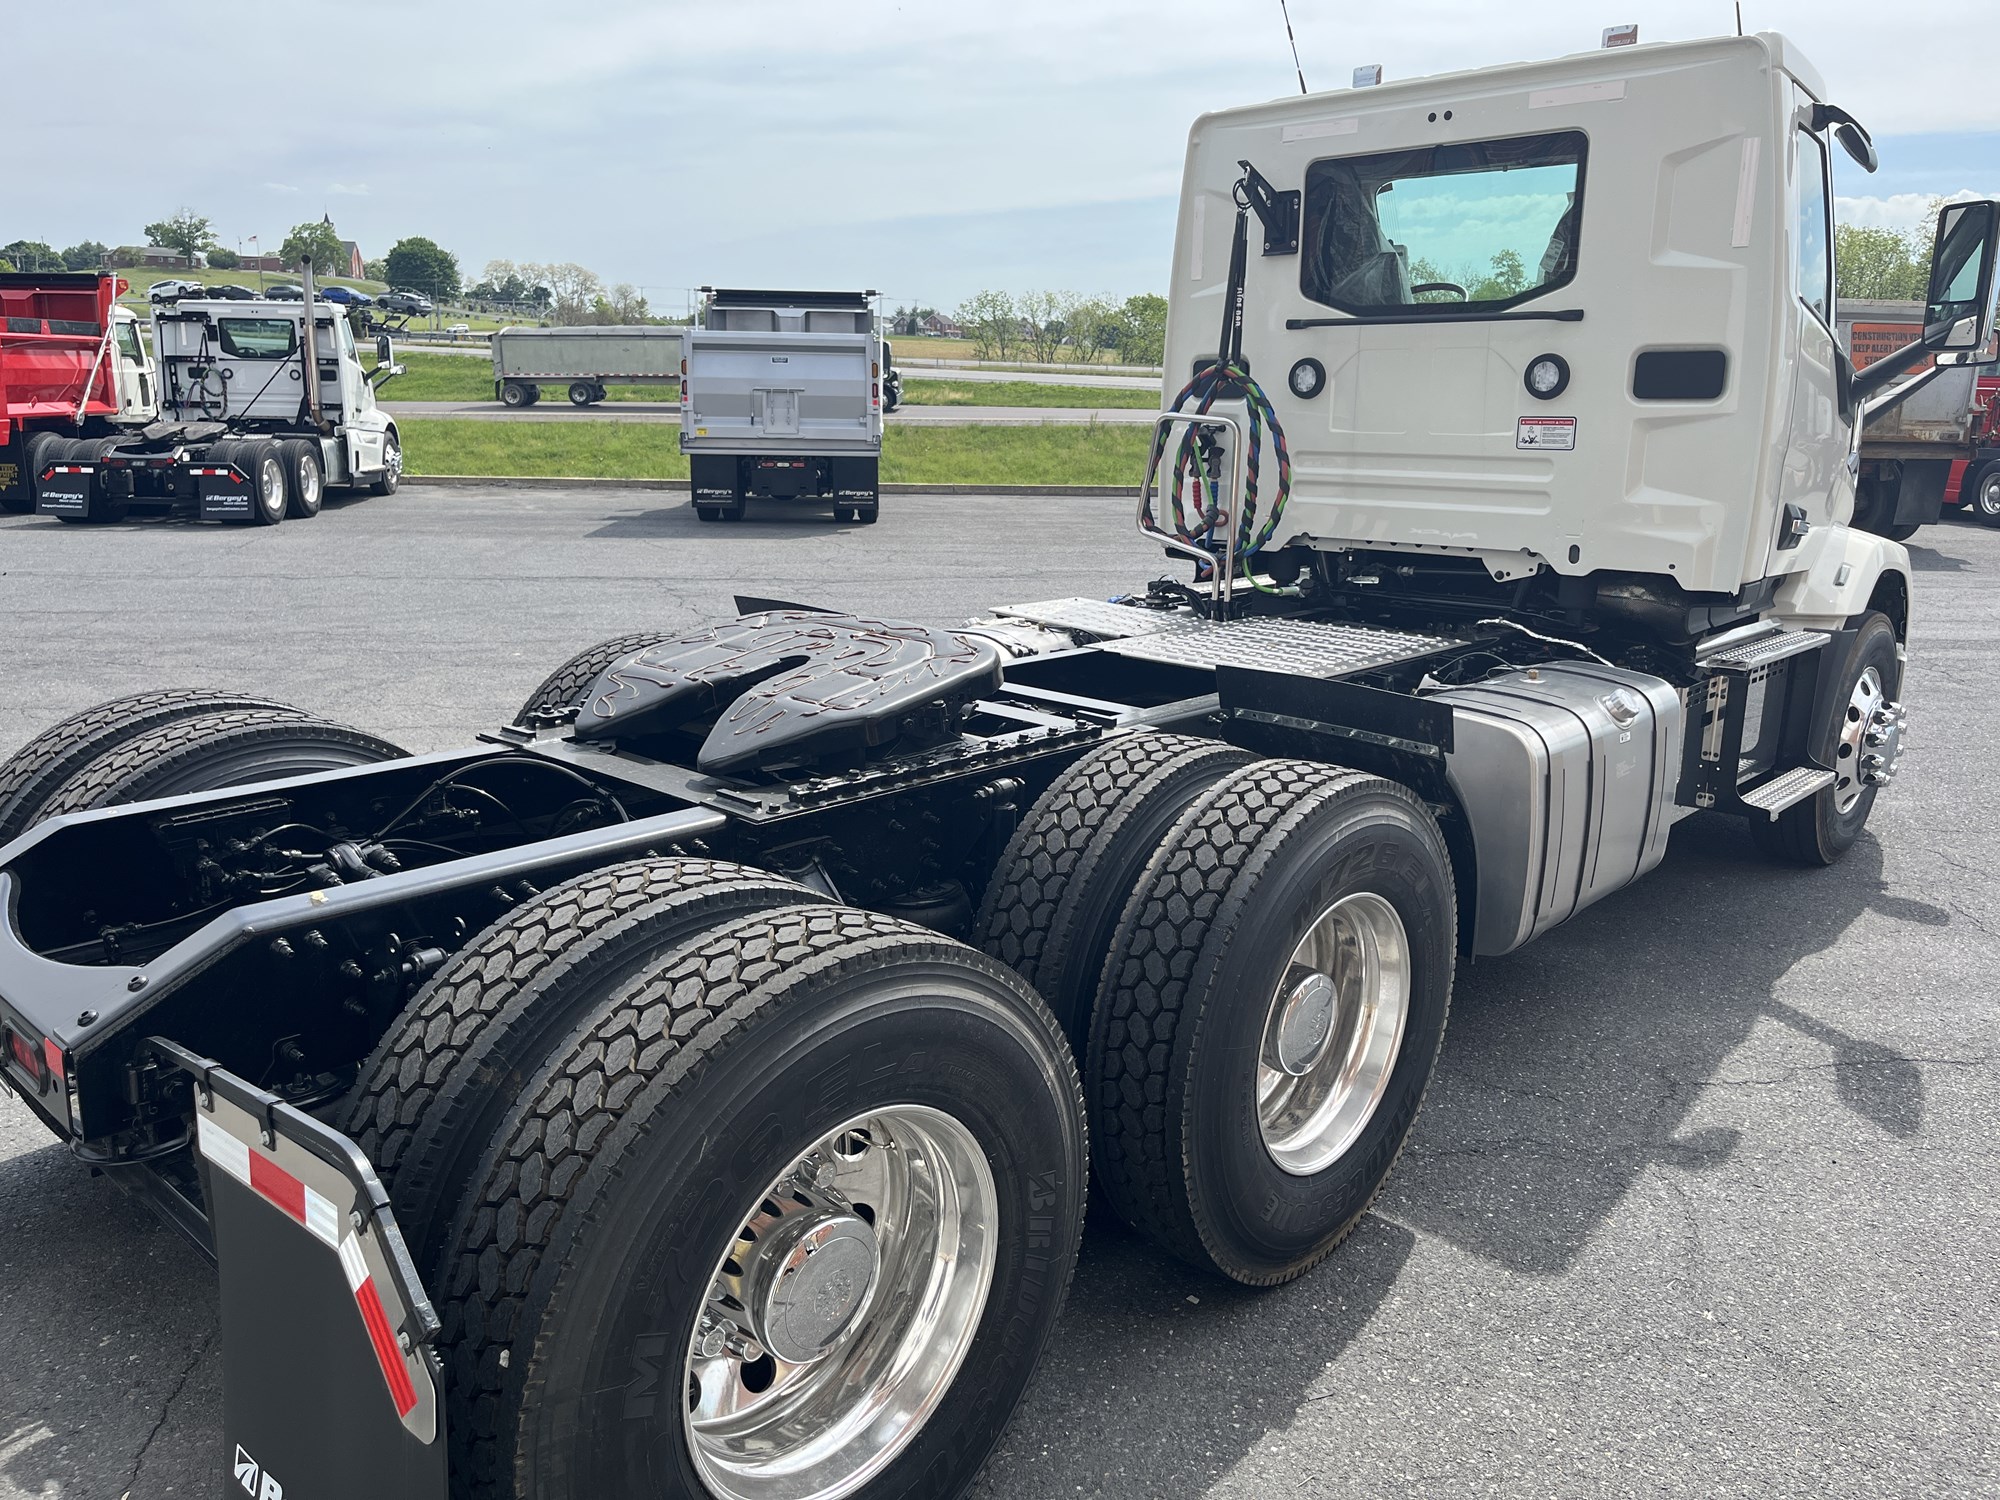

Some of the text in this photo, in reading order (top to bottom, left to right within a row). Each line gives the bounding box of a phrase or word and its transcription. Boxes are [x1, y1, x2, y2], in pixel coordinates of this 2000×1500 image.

[1852, 331, 1908, 341] CONSTRUCTION
[1853, 344, 1870, 353] KEEP
[1872, 344, 1892, 353] ALERT
